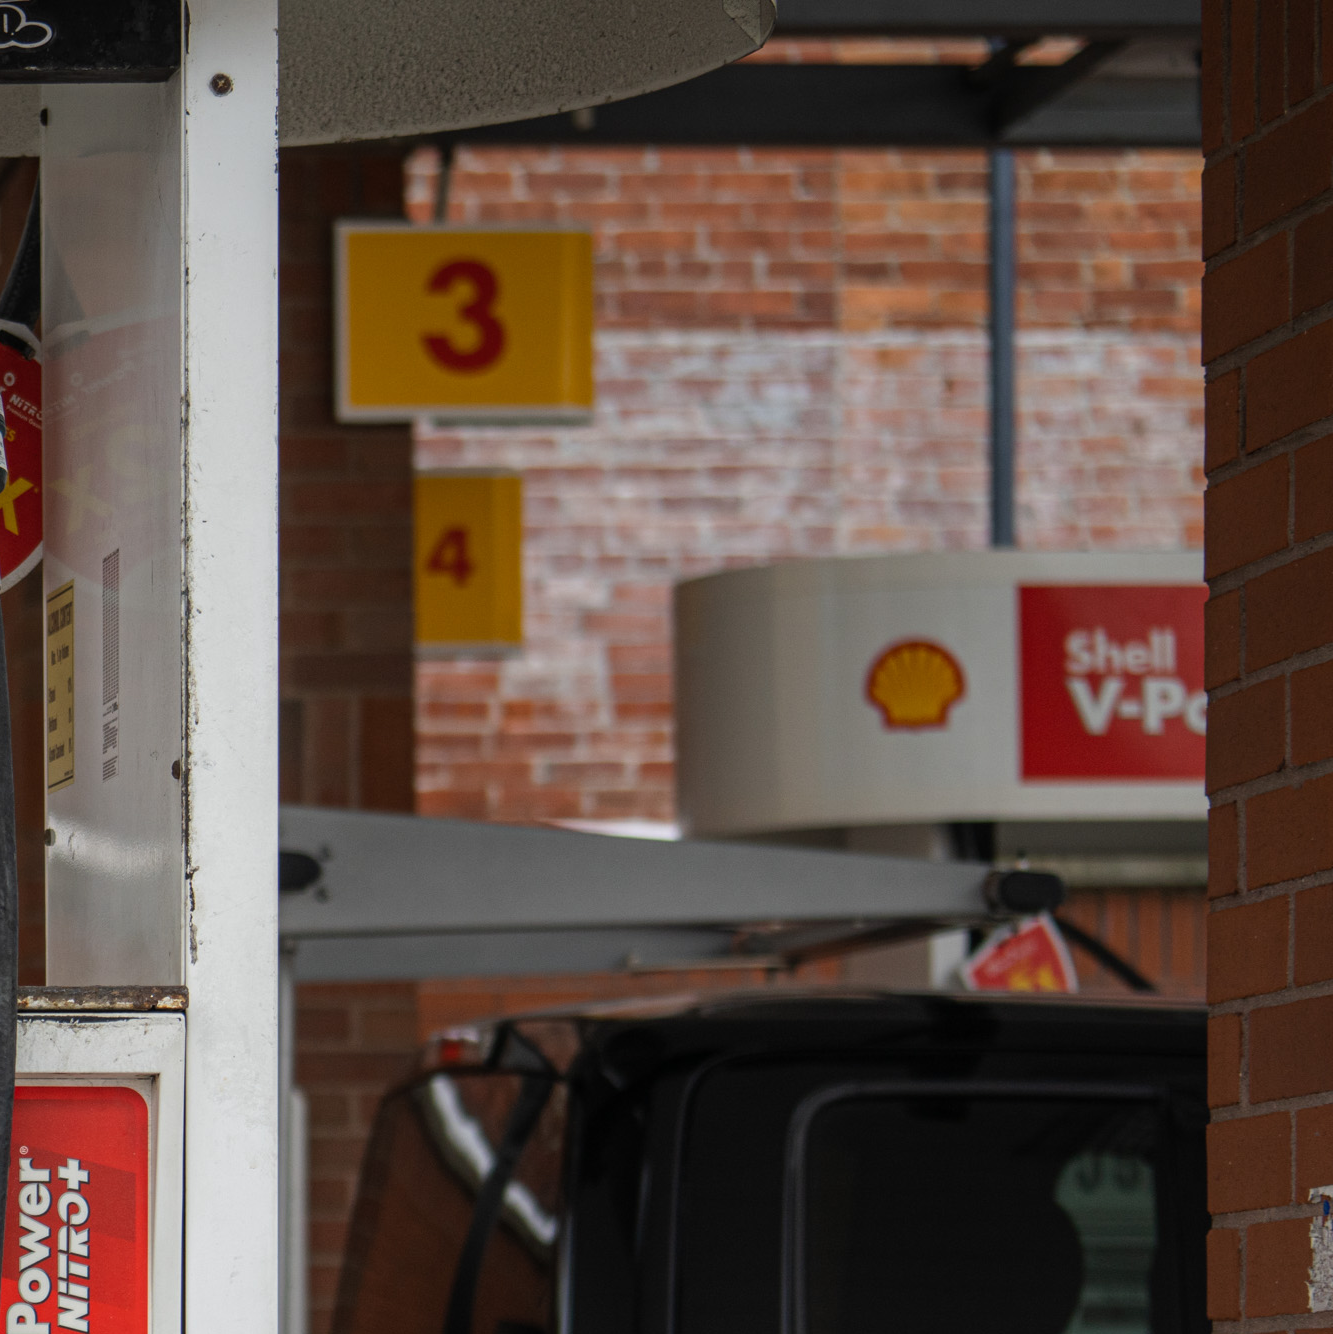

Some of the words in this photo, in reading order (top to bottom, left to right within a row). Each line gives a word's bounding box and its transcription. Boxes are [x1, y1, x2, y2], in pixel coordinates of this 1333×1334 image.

[421, 257, 507, 375] 3
[426, 526, 475, 588] 4
[1065, 629, 1175, 675] Shell
